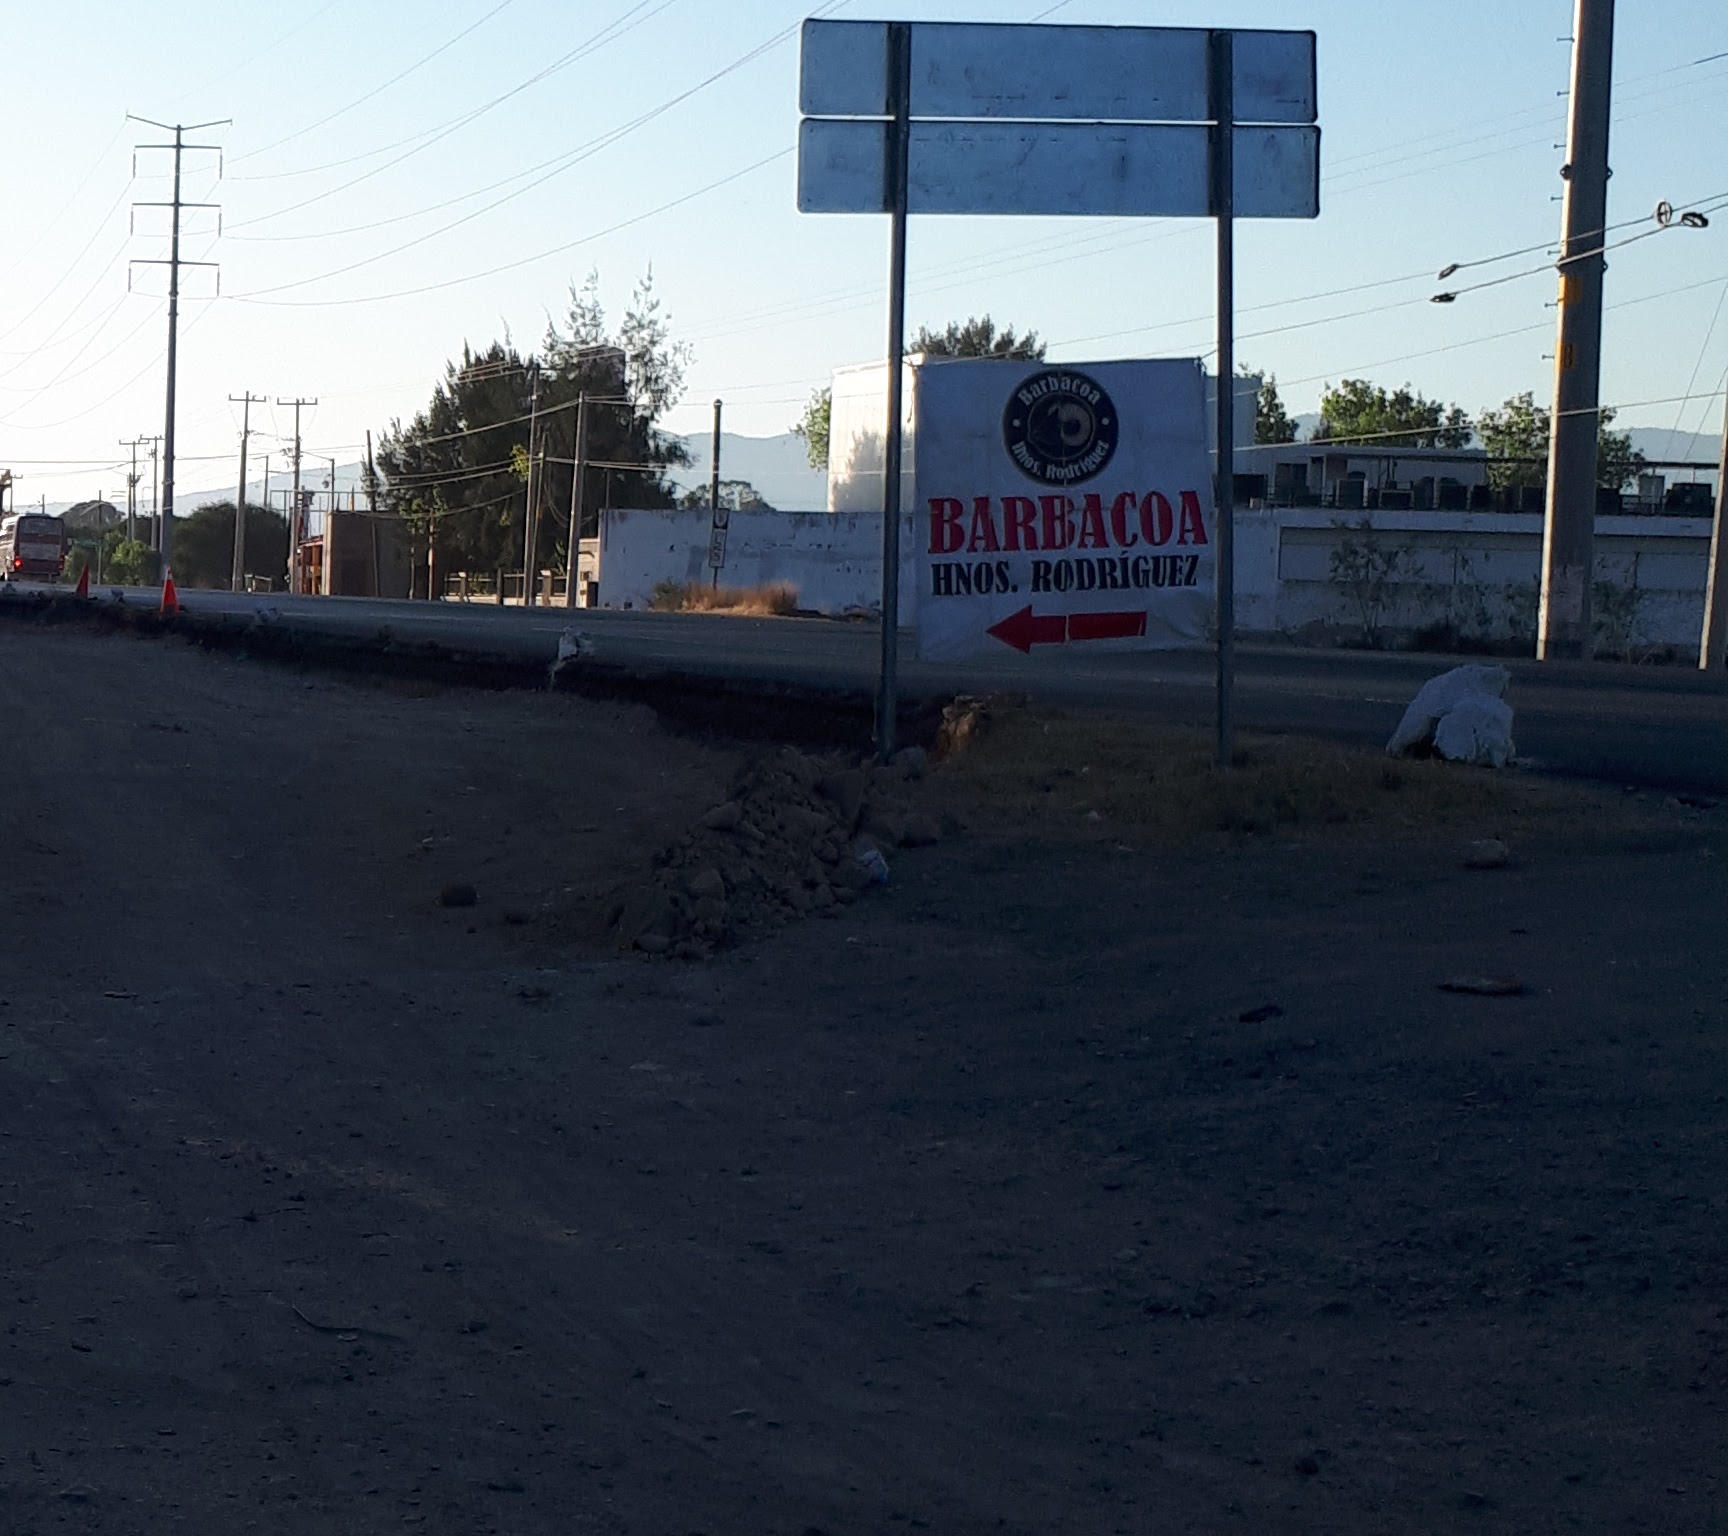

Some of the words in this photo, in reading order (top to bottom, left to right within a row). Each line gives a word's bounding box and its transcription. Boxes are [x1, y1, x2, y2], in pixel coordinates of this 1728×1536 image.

[1018, 375, 1101, 406] Barbacoa
[928, 490, 1208, 555] BARBACOA
[932, 561, 1018, 596] HNOS.
[1032, 551, 1199, 593] RODRÍGUEZ
